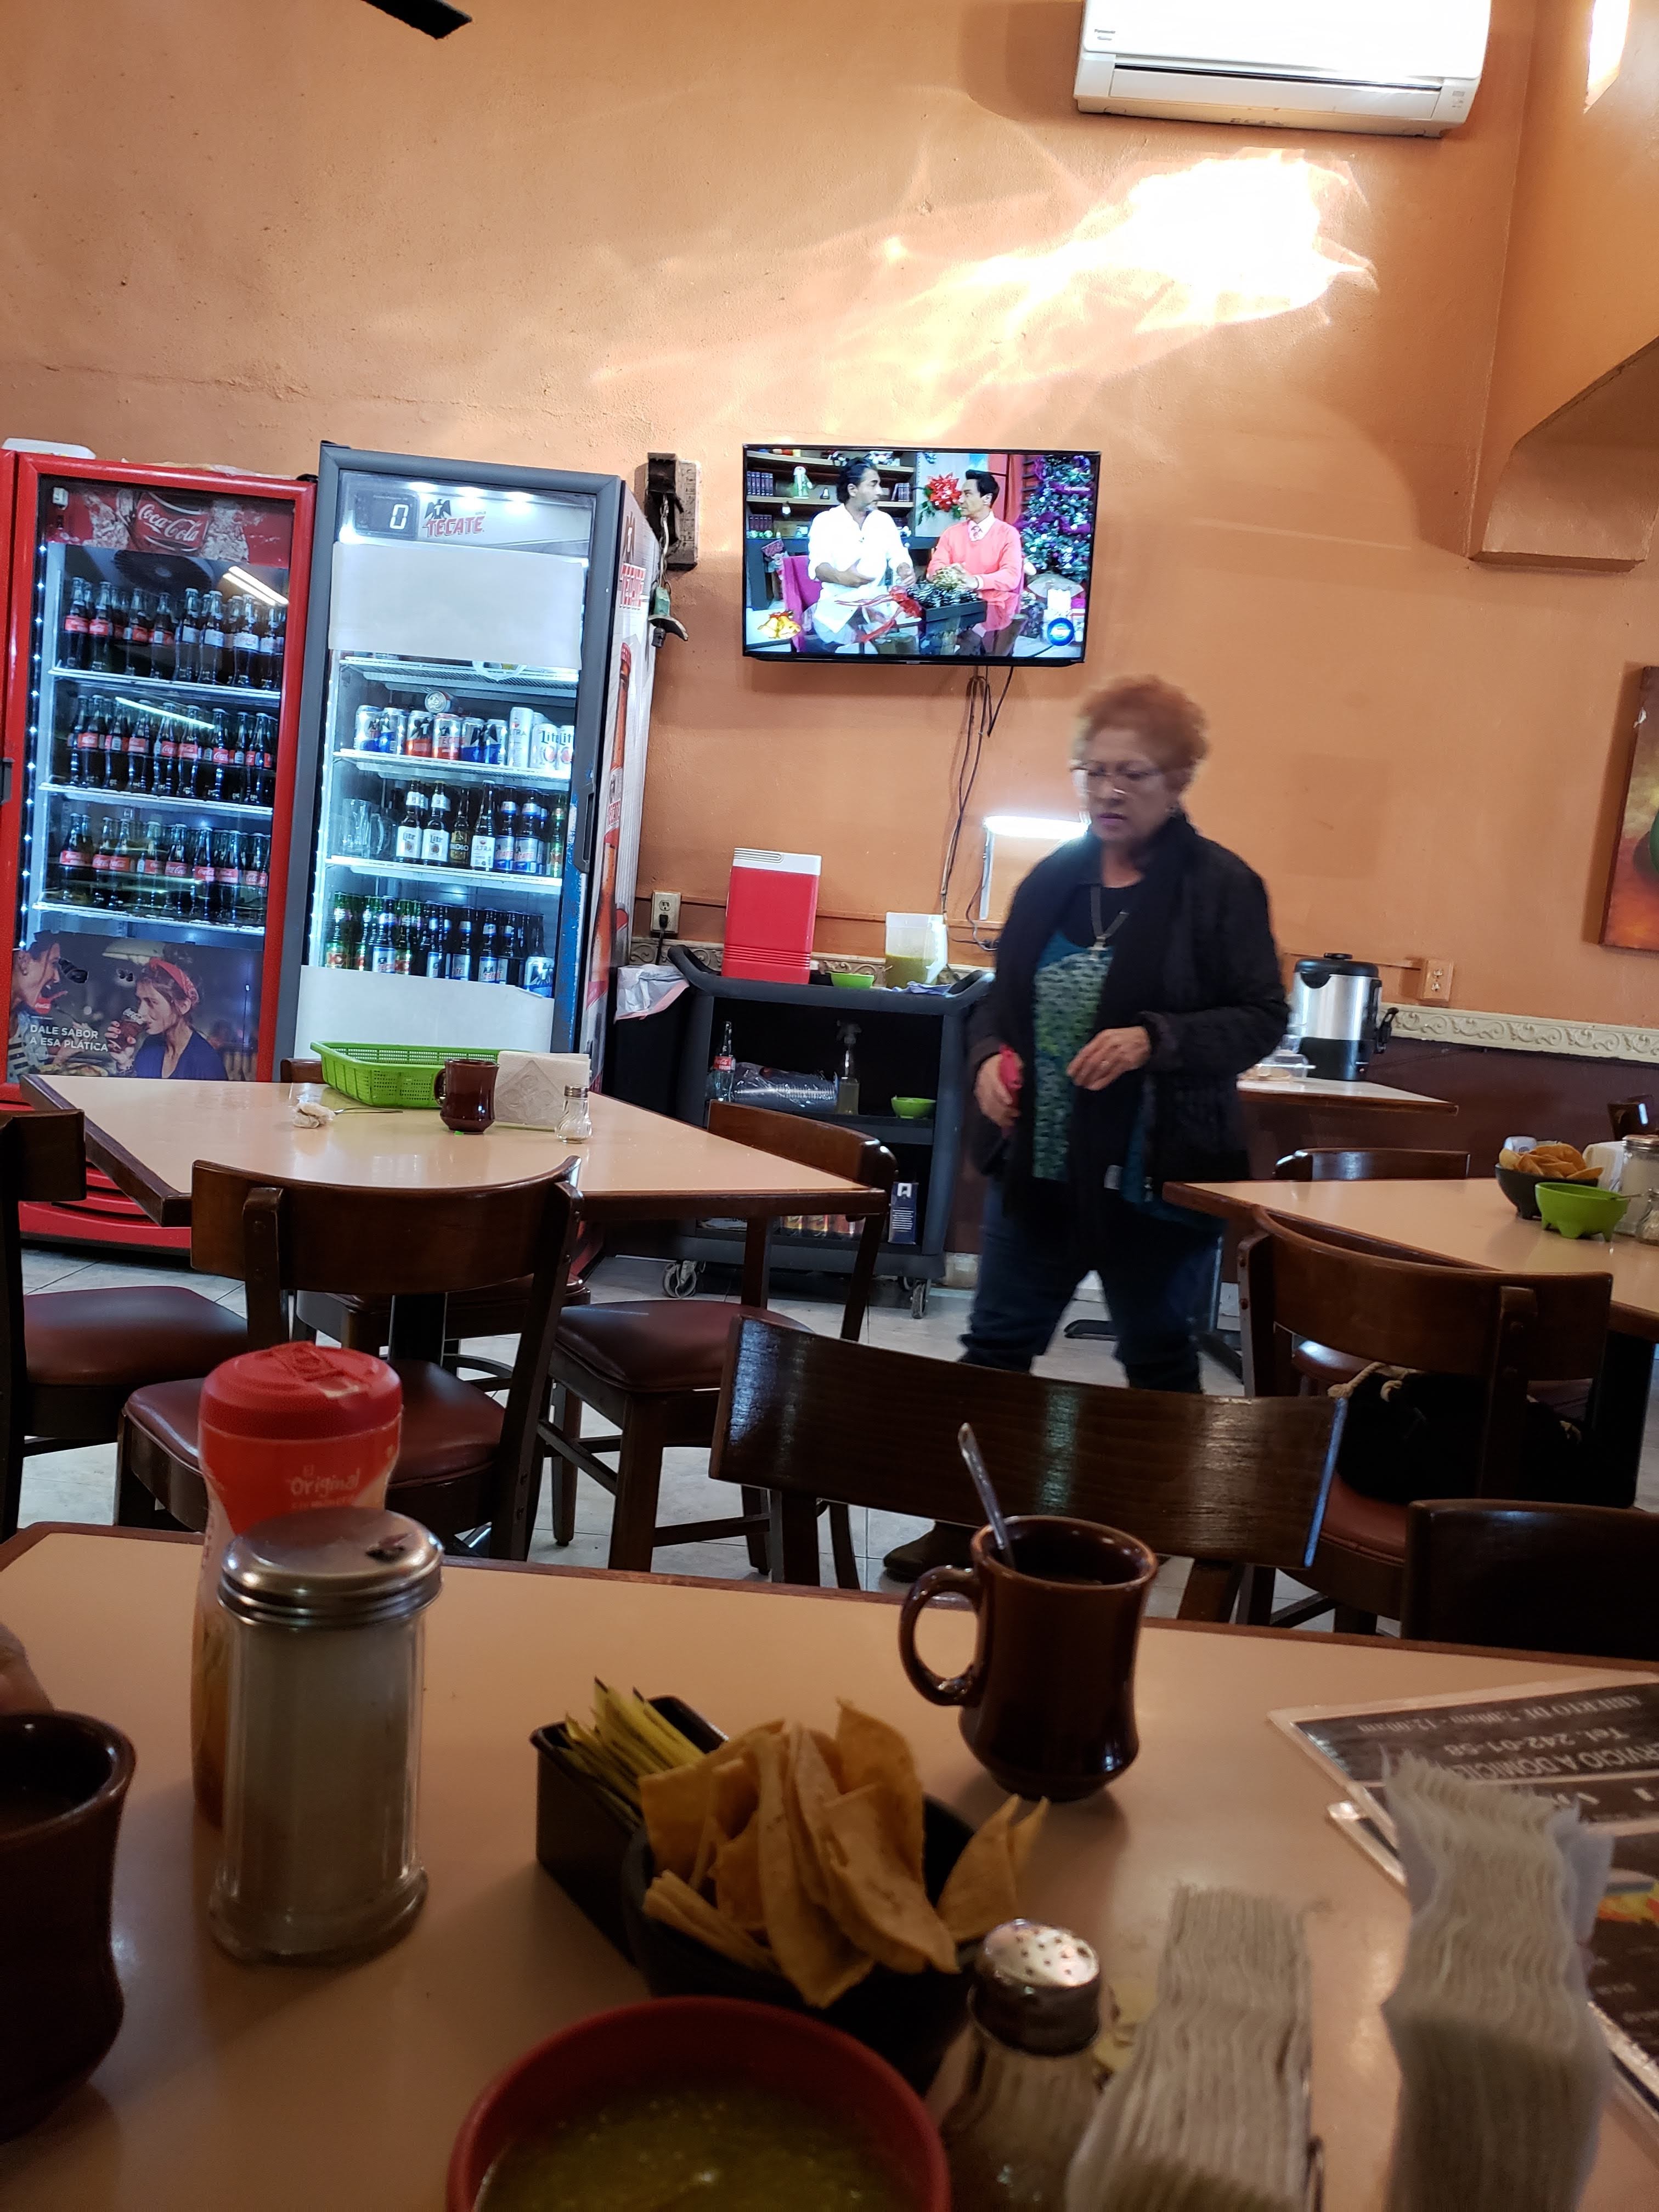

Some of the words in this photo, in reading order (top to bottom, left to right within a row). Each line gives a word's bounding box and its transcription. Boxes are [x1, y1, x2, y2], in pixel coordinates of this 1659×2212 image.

[389, 504, 409, 529] 0
[422, 516, 486, 538] TECATE
[30, 1024, 59, 1035] DALE
[61, 1028, 99, 1039] SABOR
[30, 1036, 37, 1045] A
[40, 1037, 61, 1047] ESA
[1576, 1726, 1630, 1742] Tel.
[1556, 1754, 1580, 1771] A
[1578, 1741, 1659, 1769] RVICIO
